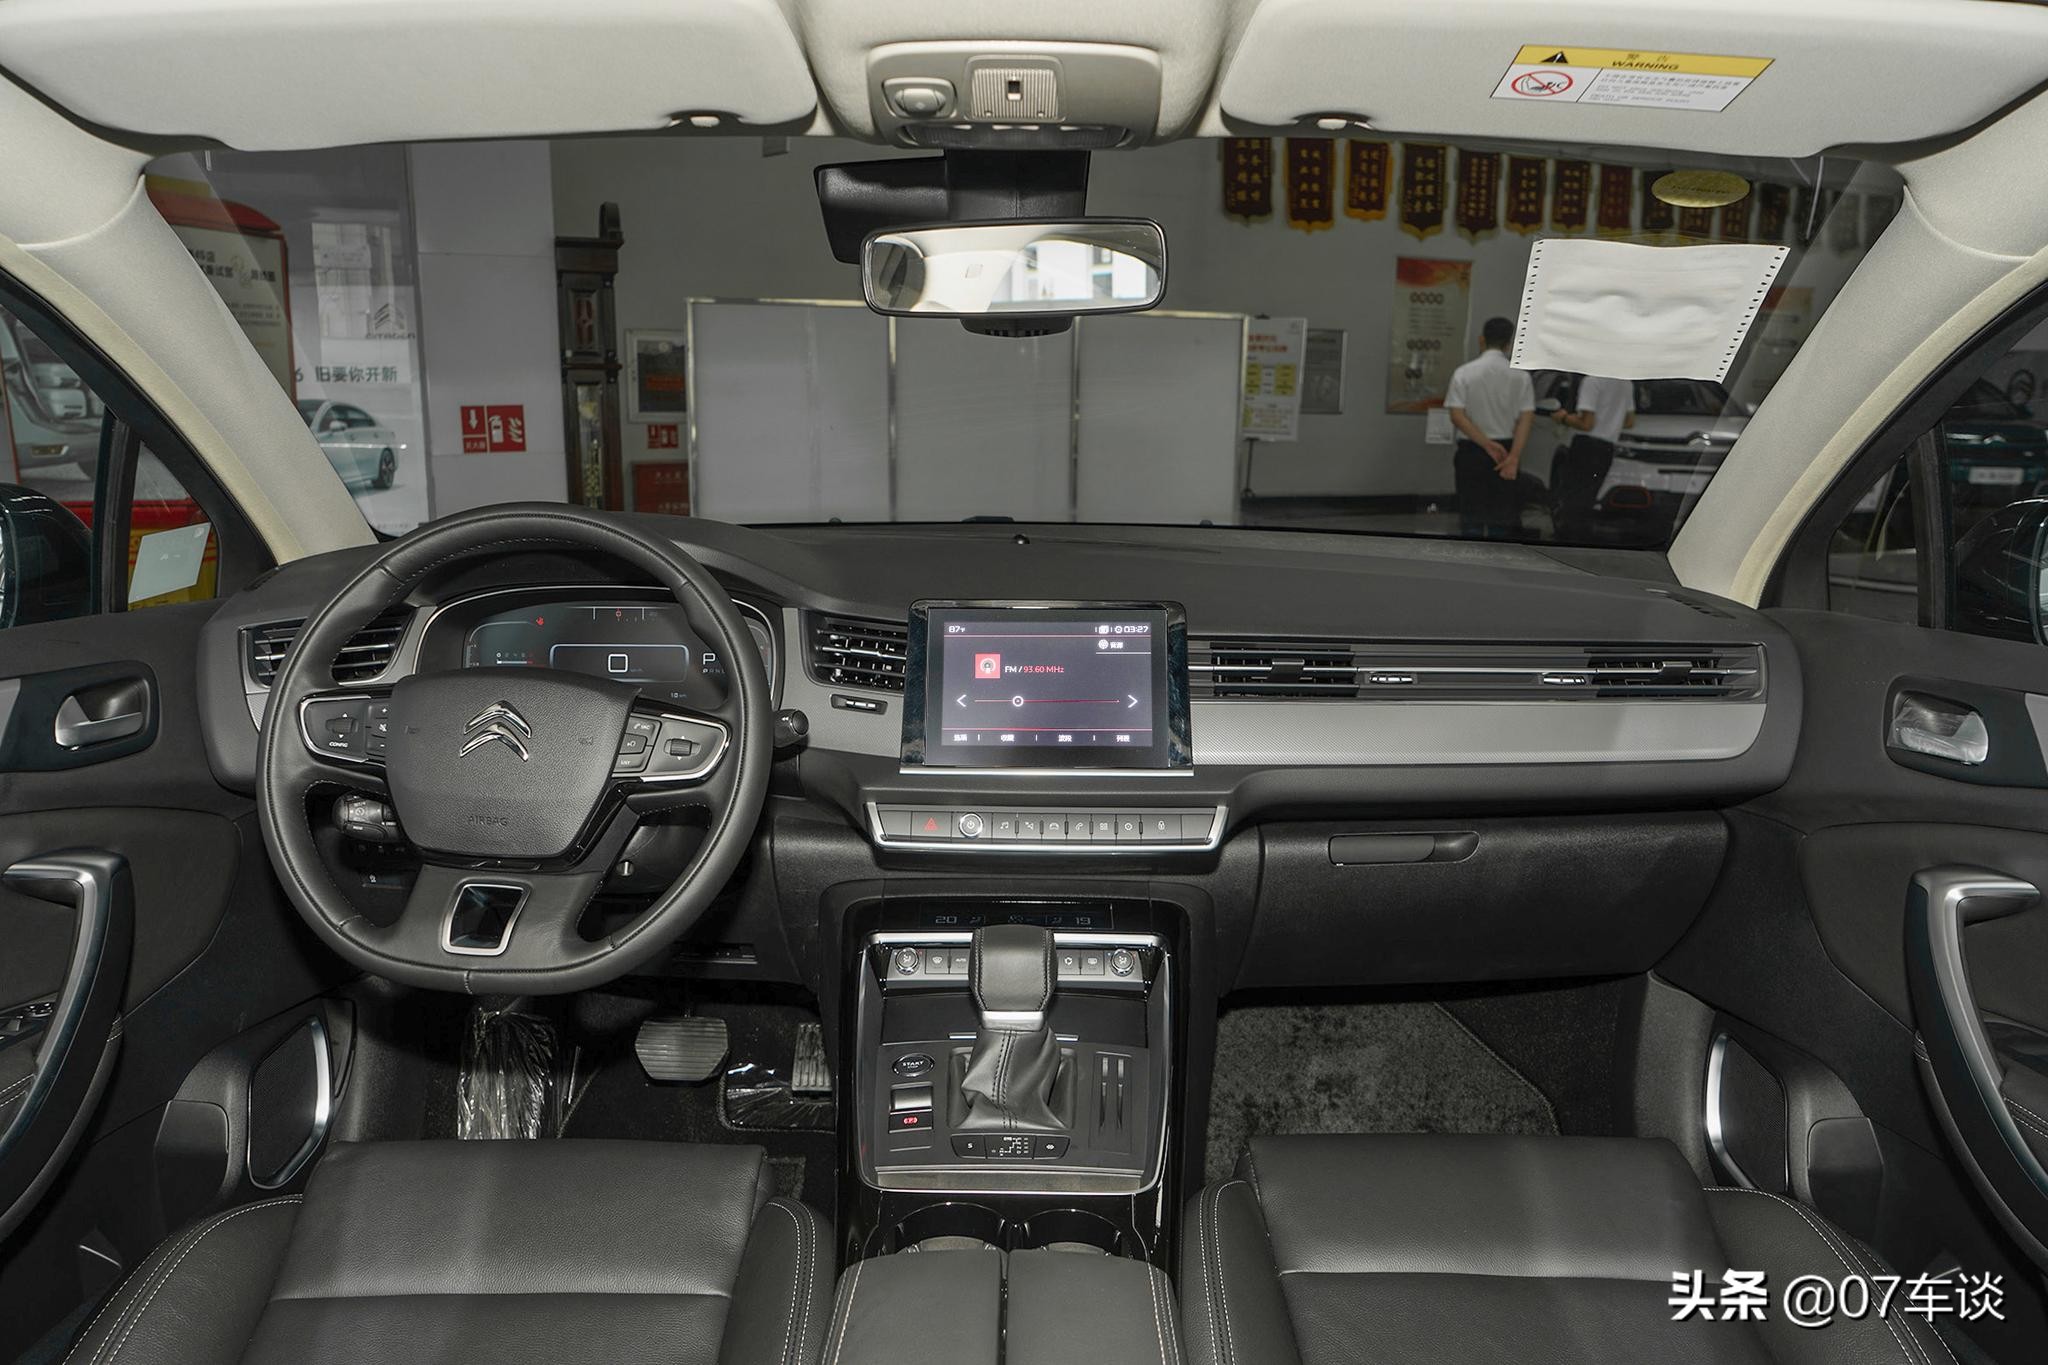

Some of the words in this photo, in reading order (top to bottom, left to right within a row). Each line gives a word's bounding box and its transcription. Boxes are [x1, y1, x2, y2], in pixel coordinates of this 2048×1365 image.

[1612, 60, 1680, 70] WARNING
[1123, 625, 1150, 633] 03:27
[702, 653, 716, 665] P
[1004, 665, 1017, 673] FM
[1023, 665, 1045, 674] 93.60
[1046, 665, 1065, 674] MHz
[467, 815, 508, 827] AIRBAG
[935, 915, 958, 924] 20
